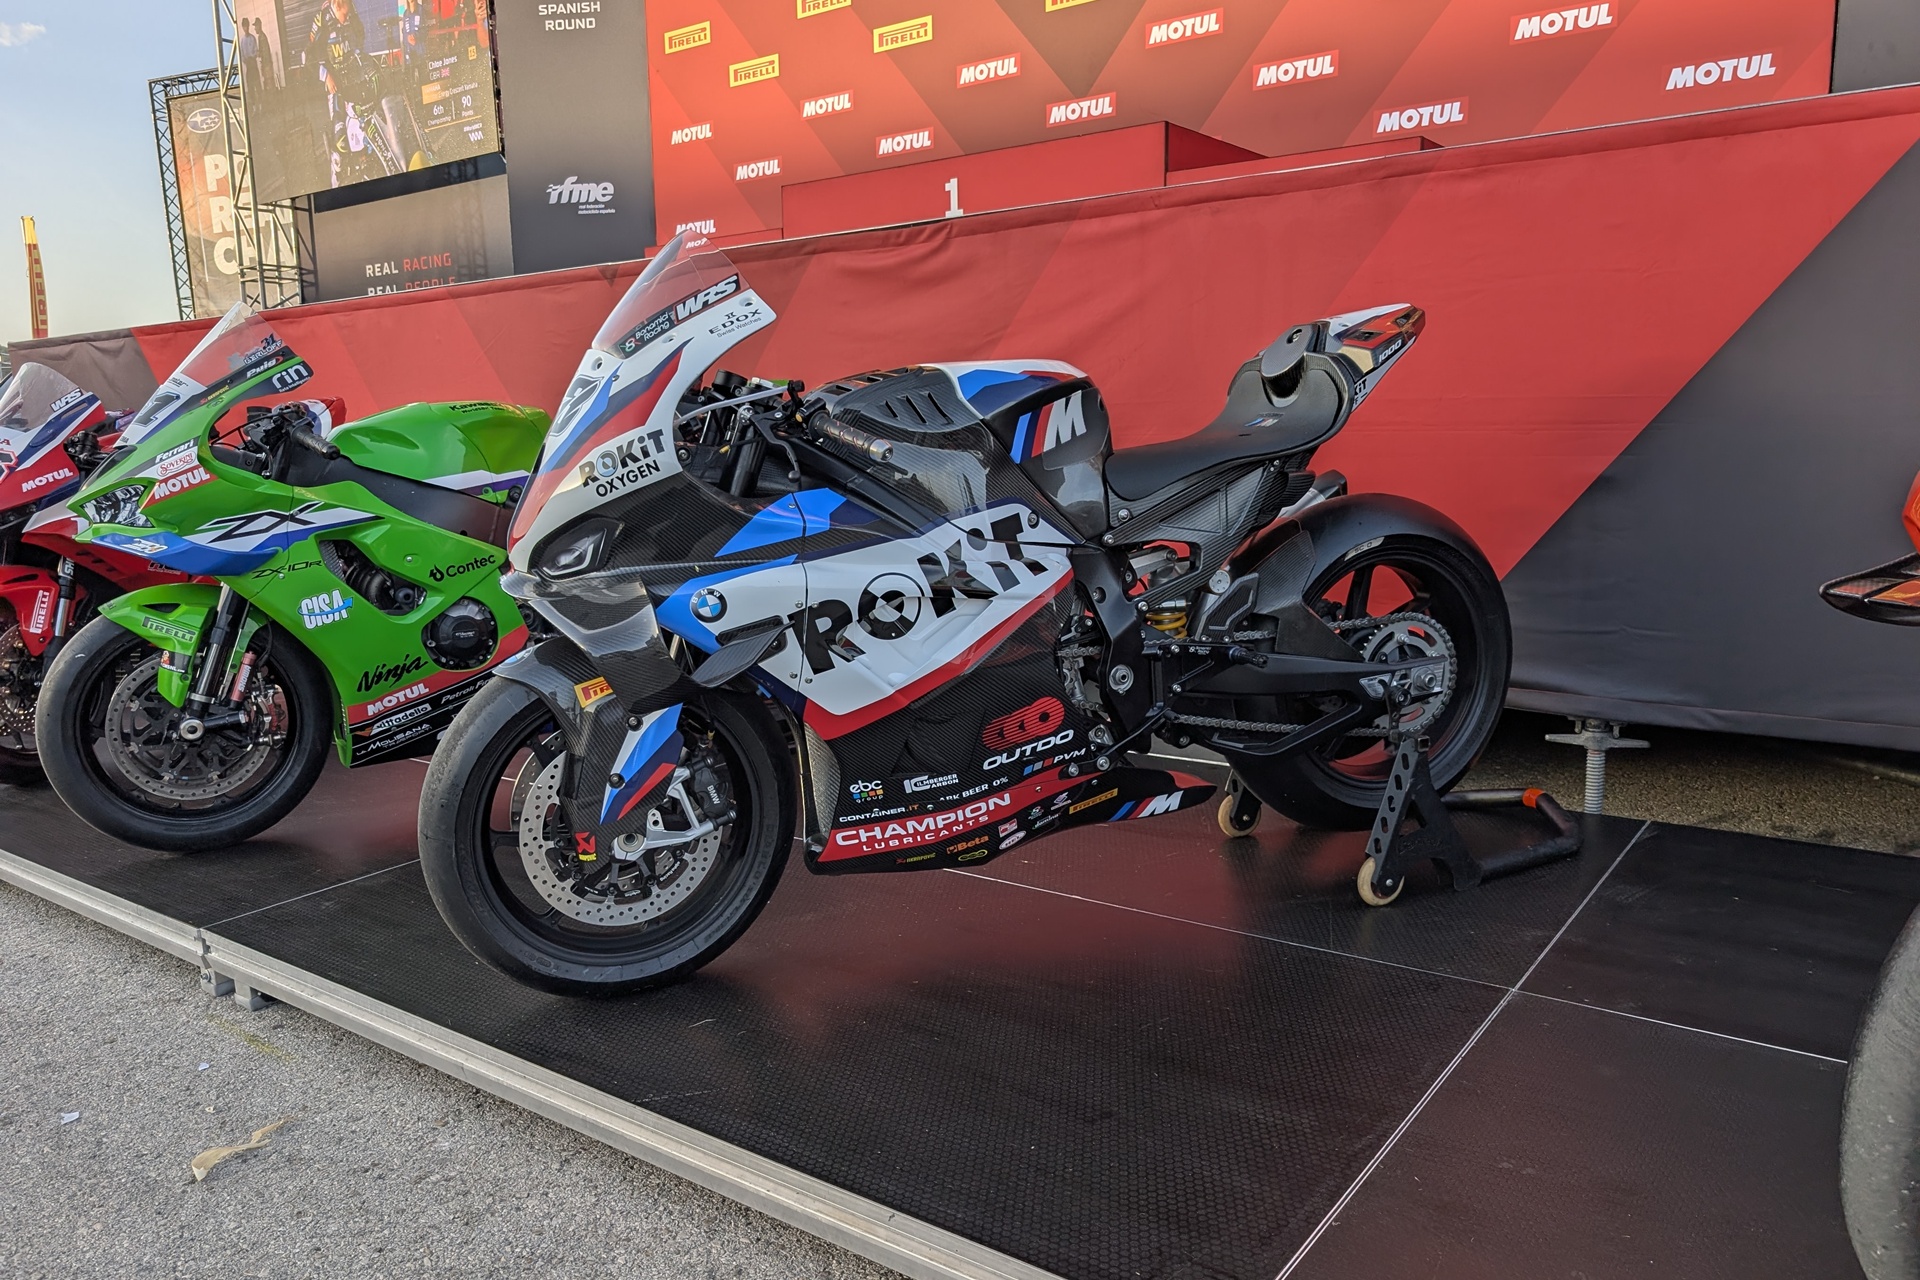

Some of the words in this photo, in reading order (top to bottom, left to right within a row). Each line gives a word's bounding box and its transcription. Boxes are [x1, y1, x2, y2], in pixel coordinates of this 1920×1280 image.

[538, 1, 600, 15] SPANISH
[545, 18, 596, 31] ROUND
[878, 20, 928, 48] PIRELLI
[1148, 12, 1221, 44] MOTUL
[1514, 4, 1613, 40] MOTUL
[667, 27, 708, 50] PIRELLI
[733, 60, 775, 83] PIRELLI
[959, 56, 1018, 85] MOTUL
[1255, 54, 1335, 87] MOTUL
[1665, 53, 1777, 91] MOTUL
[433, 105, 444, 115] 6th
[462, 95, 472, 108] 90
[802, 93, 851, 117] MOTUL
[1049, 95, 1114, 124] MOTUL
[1376, 101, 1464, 134] MOTUL
[671, 123, 712, 145] MOTUL
[878, 131, 931, 155] MOTUL
[735, 158, 780, 181] MOTUL
[546, 176, 615, 204] rfme
[944, 177, 964, 218] 1
[675, 219, 717, 235] MOTUL
[366, 261, 399, 277] REAL
[403, 253, 452, 271] RACING
[676, 274, 738, 321] WRS
[644, 321, 670, 341] Racing
[709, 308, 762, 335] EDOX
[717, 326, 735, 338] Swiss
[735, 317, 762, 332] Watches
[1378, 339, 1402, 363] 1000
[246, 358, 277, 379] Puig
[51, 389, 82, 412] WRS
[155, 439, 195, 464] Ferrari
[21, 467, 74, 493] MOTUL
[154, 467, 211, 500] MOTUL
[596, 459, 661, 498] OXYGEN
[446, 554, 496, 578] Contec
[29, 589, 50, 634] PIRELLI
[300, 589, 350, 630] CISA
[142, 616, 197, 643] PIRELLI
[356, 654, 429, 693] Ninja
[367, 683, 429, 717] MOTUL
[982, 729, 1074, 770] OUTDO
[1054, 748, 1087, 764] PVM
[707, 784, 721, 805] BMW
[850, 780, 883, 794] ebc
[856, 794, 884, 804] group
[962, 784, 989, 798] BEER
[993, 776, 1009, 787] 0%
[835, 793, 1011, 846] CHAMPION
[863, 815, 989, 851] LUBRICANTS
[957, 835, 989, 850] Beta
